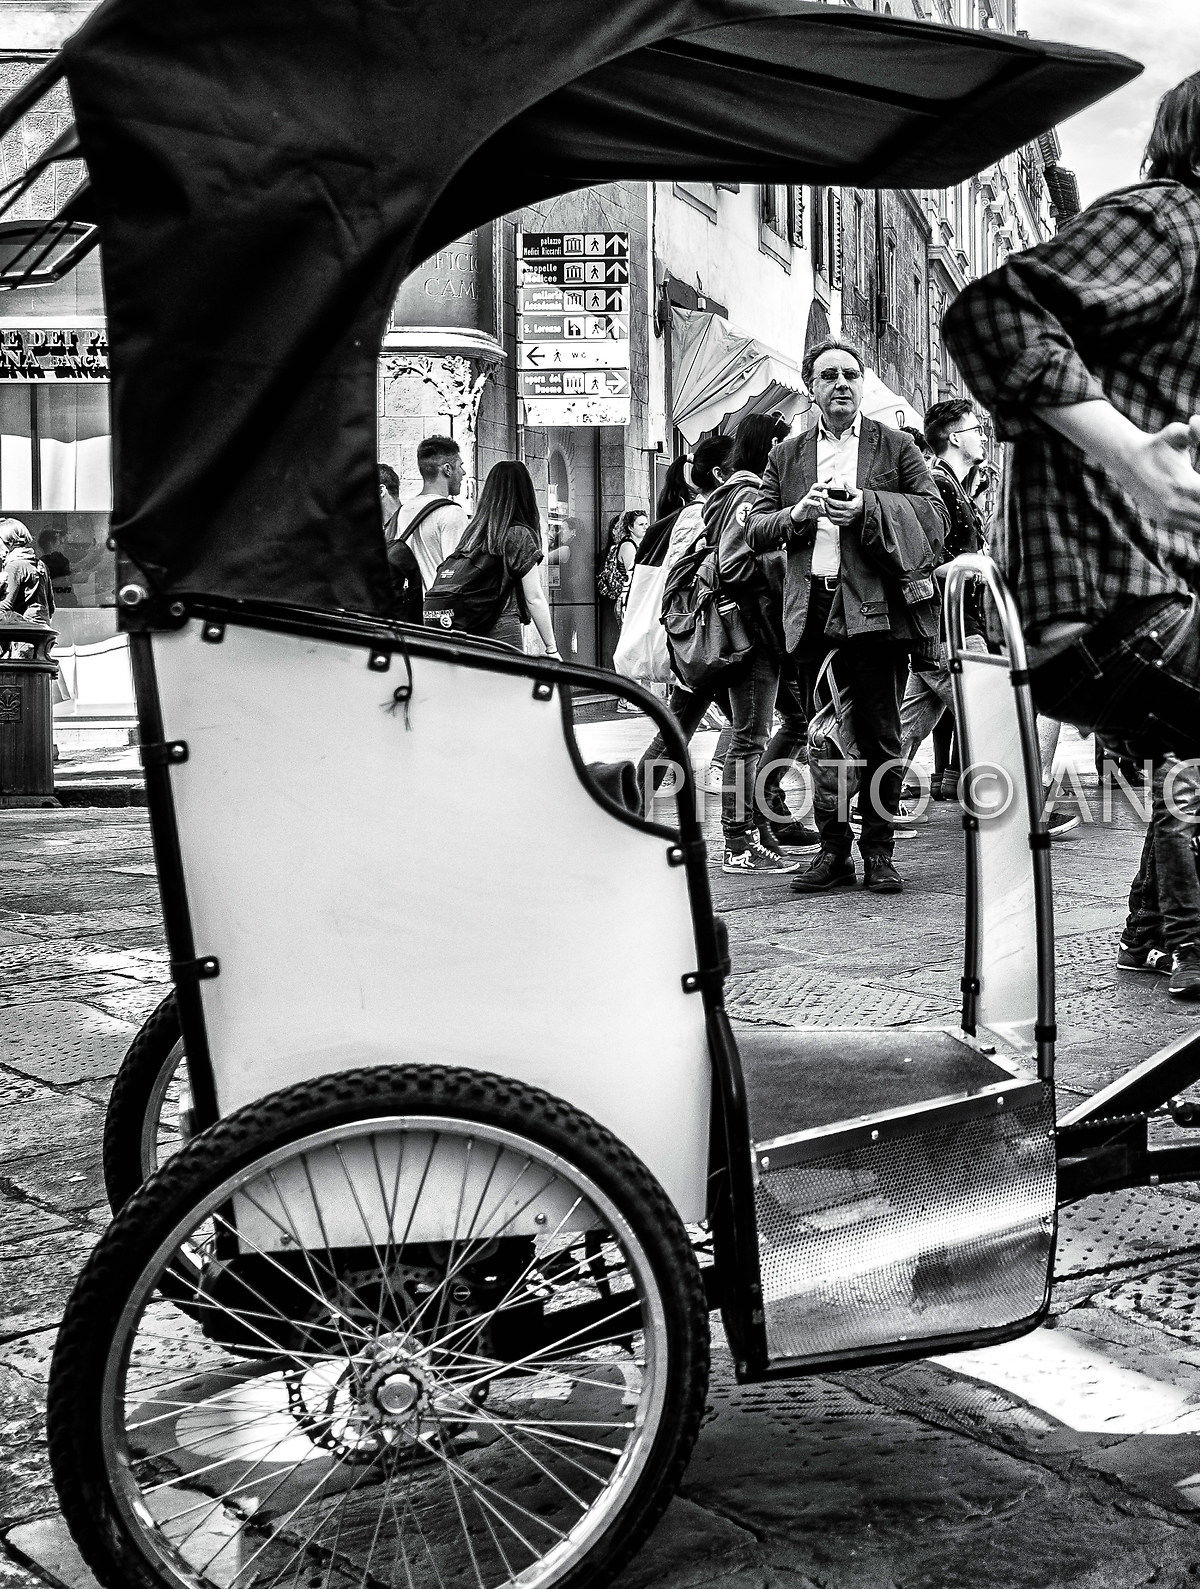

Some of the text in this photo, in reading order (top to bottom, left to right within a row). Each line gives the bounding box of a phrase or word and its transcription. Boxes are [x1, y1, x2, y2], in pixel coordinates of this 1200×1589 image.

[540, 236, 562, 247] palazzo
[523, 246, 562, 256] Medici Riccardi
[26, 329, 75, 347] DEI
